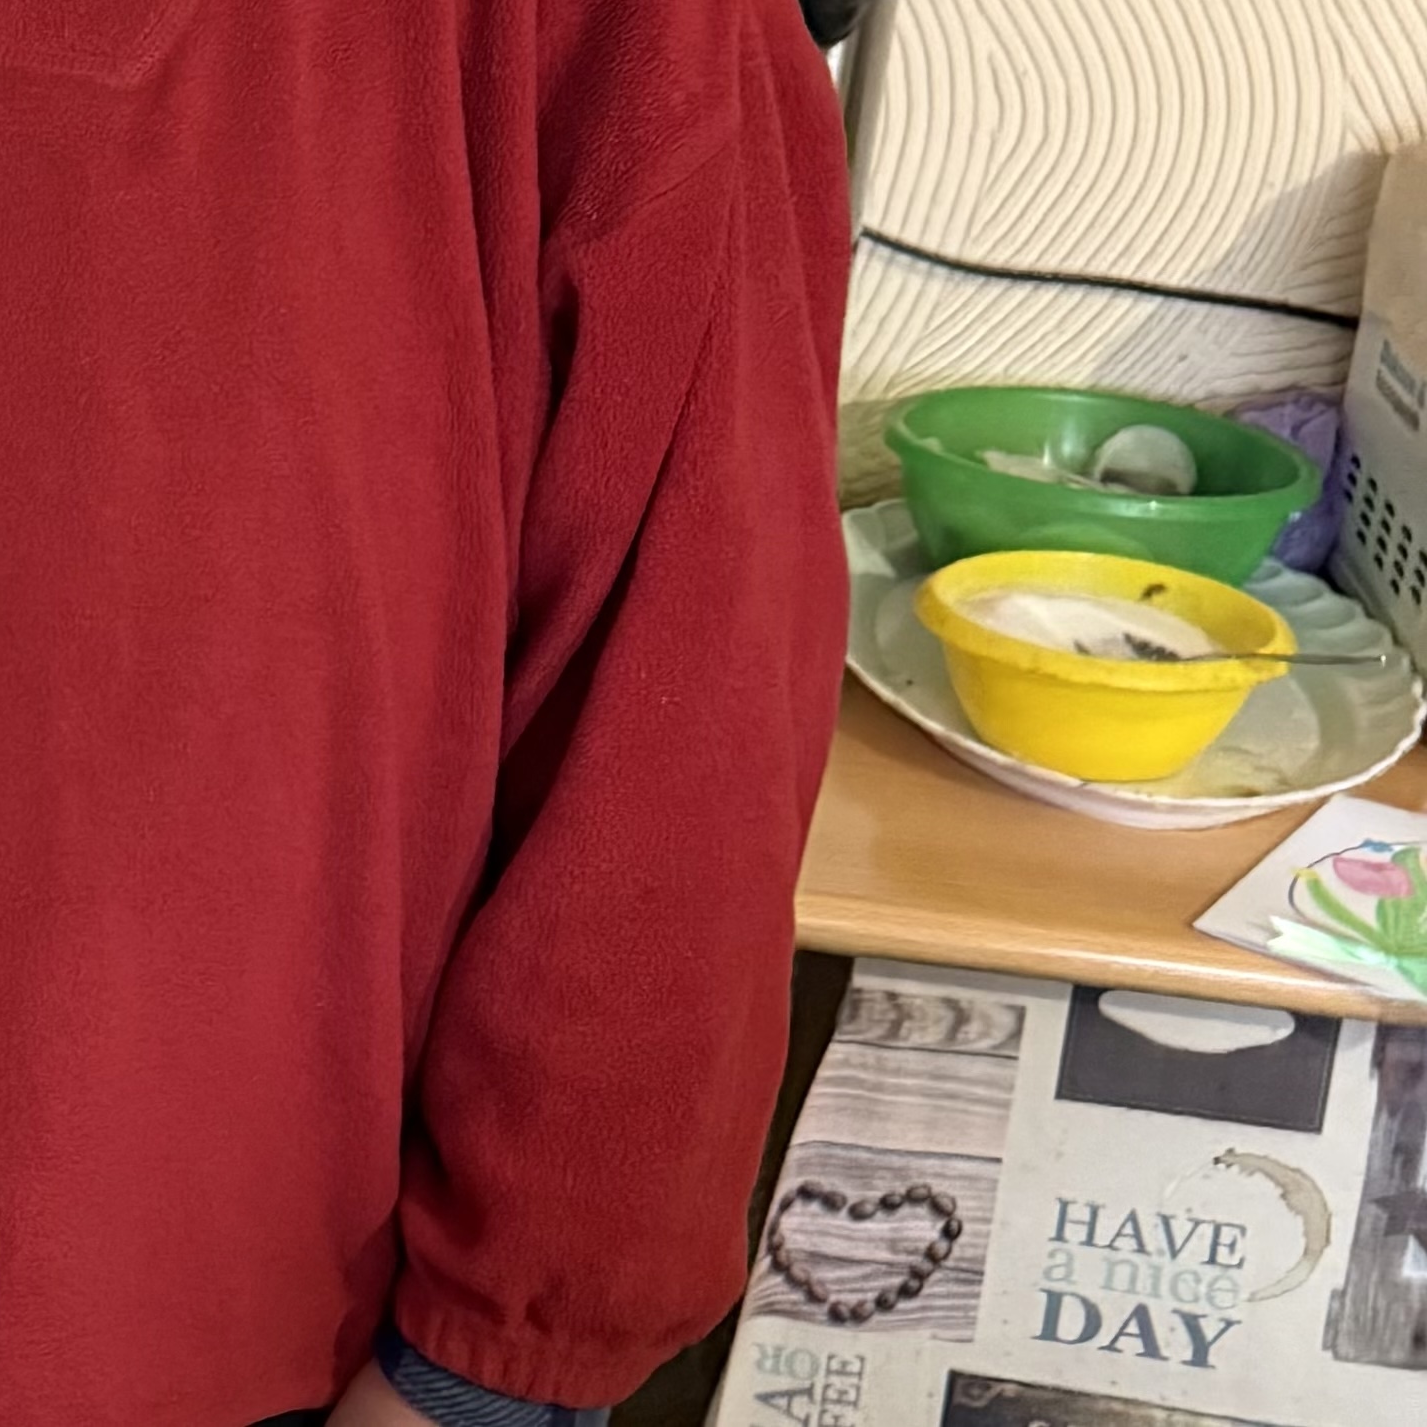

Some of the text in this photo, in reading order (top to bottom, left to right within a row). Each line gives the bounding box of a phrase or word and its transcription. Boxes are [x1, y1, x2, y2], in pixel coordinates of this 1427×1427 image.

[1048, 1196, 1247, 1270] HAVE
[1042, 1246, 1241, 1311] a nice
[1030, 1287, 1242, 1370] DAY
